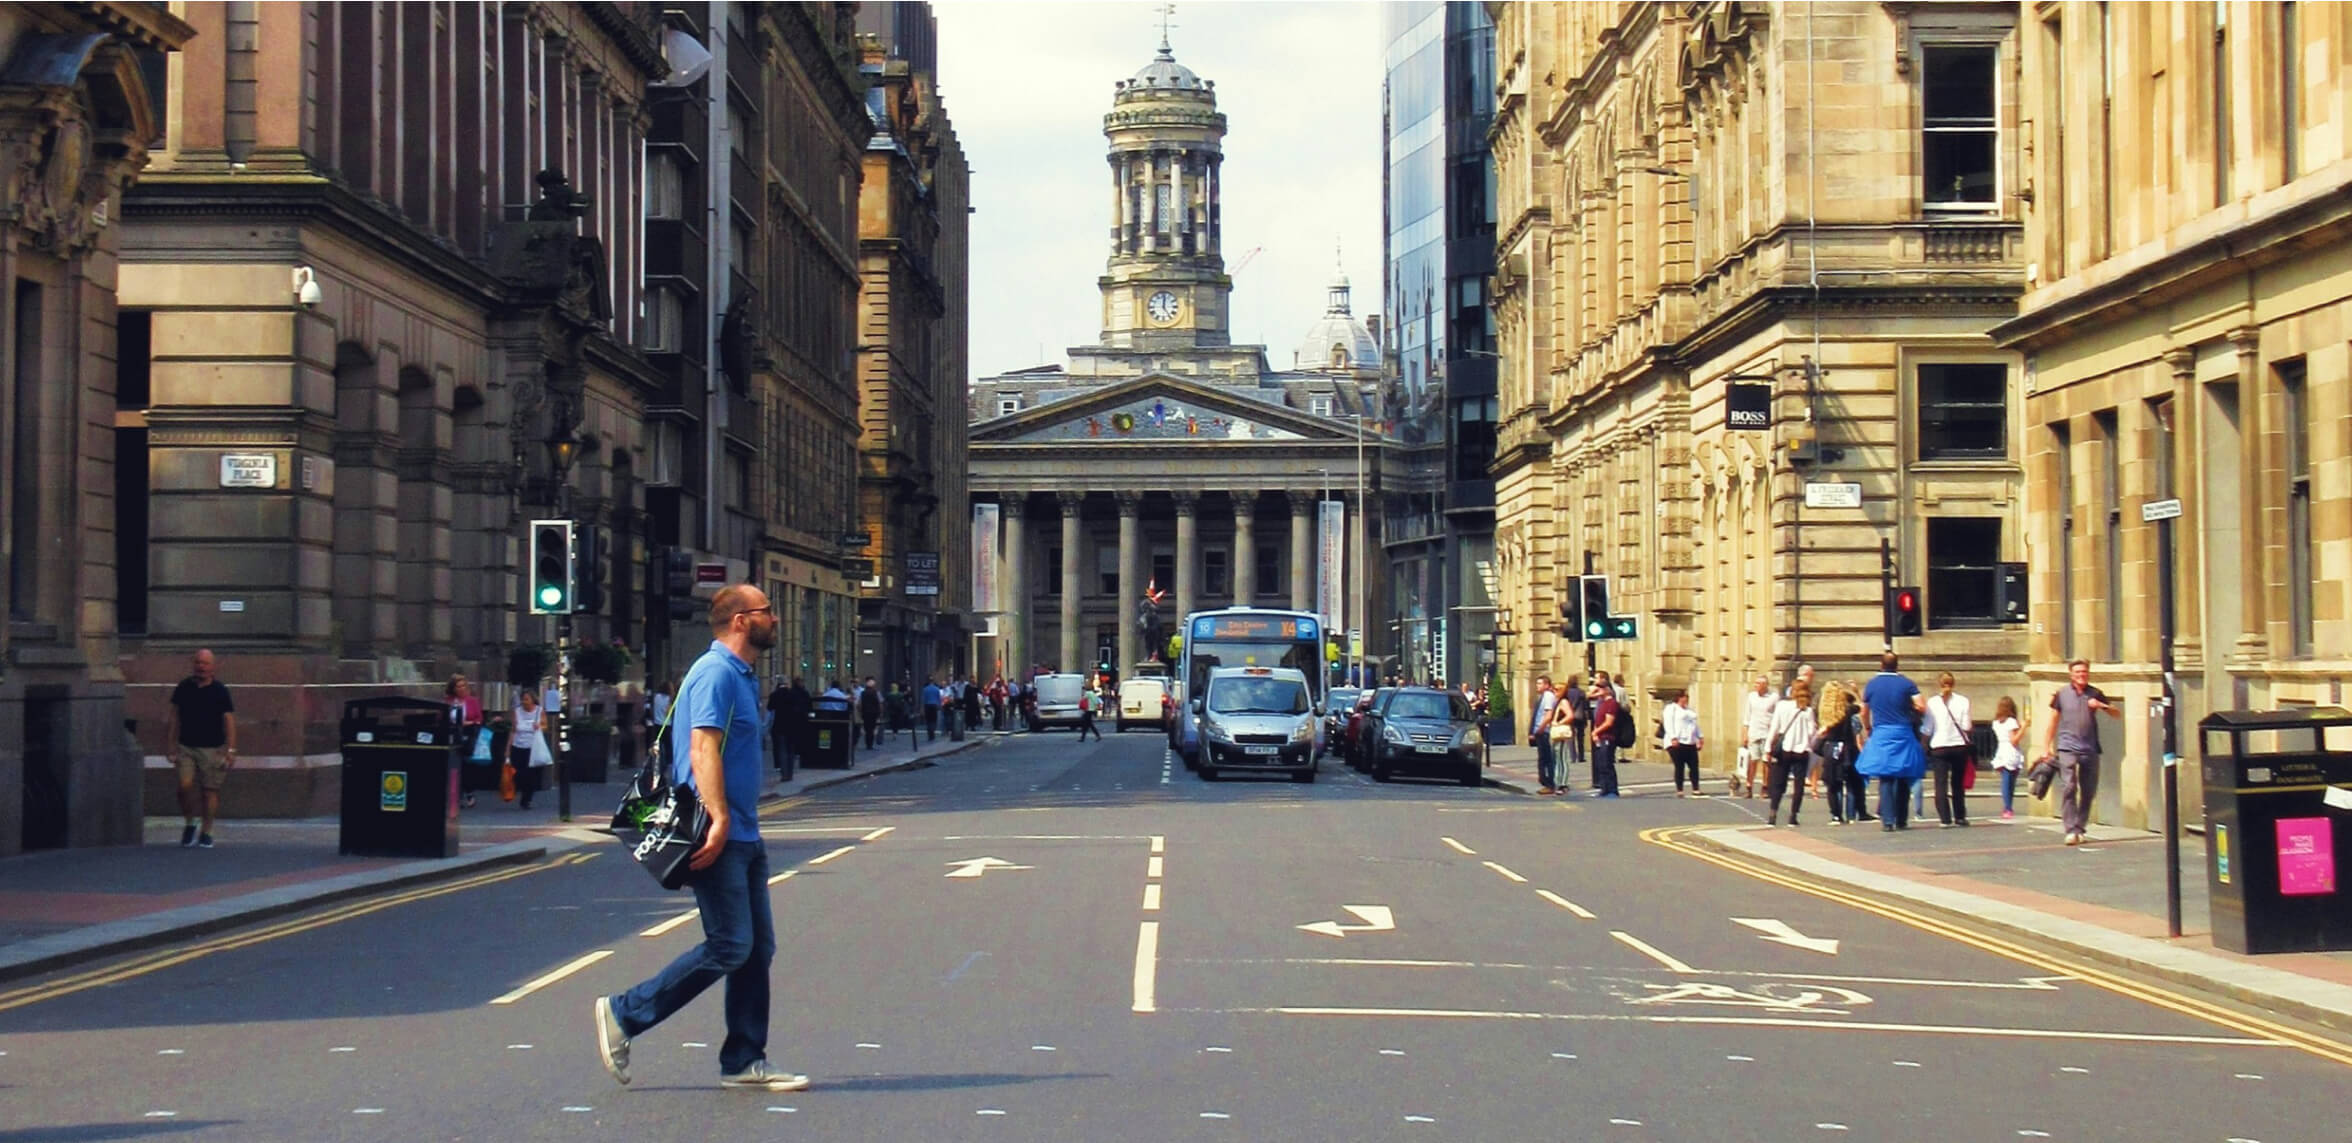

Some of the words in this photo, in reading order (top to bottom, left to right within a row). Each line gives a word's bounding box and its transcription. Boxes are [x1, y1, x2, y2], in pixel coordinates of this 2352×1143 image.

[1731, 410, 1766, 421] BOSS
[227, 458, 269, 468] VIRGINIA
[232, 469, 262, 479] PLACE
[907, 560, 918, 568] TO
[921, 560, 937, 568] LET
